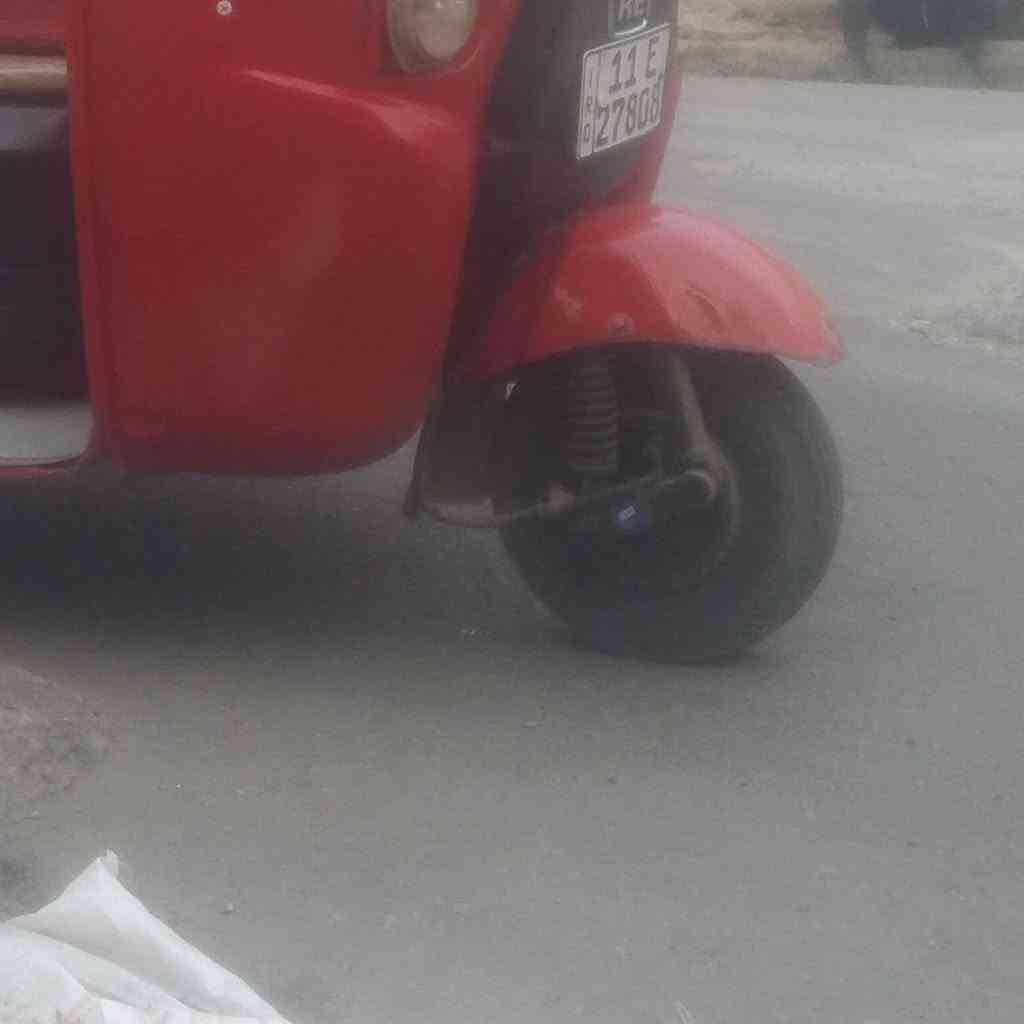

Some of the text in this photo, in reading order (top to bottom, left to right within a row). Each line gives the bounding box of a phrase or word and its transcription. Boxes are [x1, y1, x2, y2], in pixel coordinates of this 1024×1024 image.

[608, 37, 660, 94] 11 E
[595, 84, 661, 147] 27808
